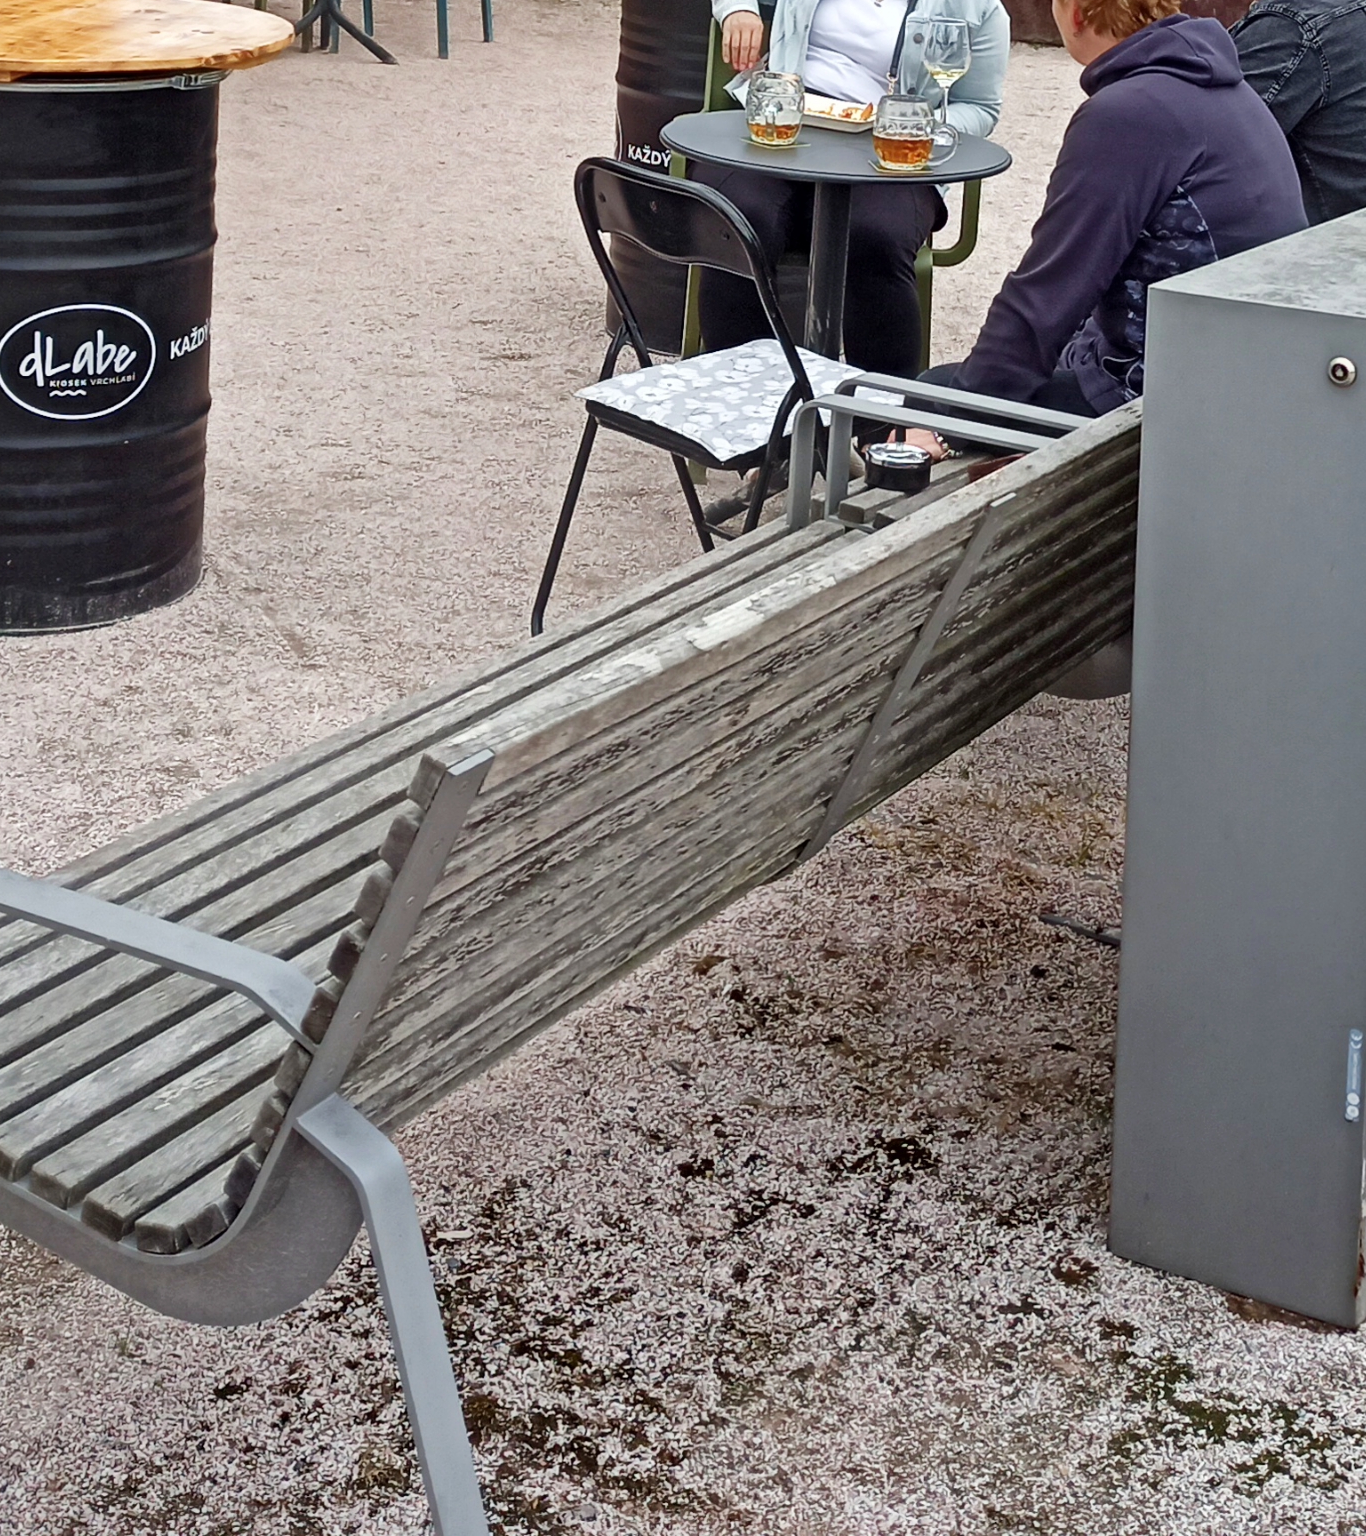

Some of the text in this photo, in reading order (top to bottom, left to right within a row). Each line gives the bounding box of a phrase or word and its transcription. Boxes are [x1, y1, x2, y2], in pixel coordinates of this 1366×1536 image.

[627, 143, 672, 168] KAŽDÝ
[18, 329, 137, 388] dLabe
[49, 371, 136, 388] KIOSEK VRCHLABÍ
